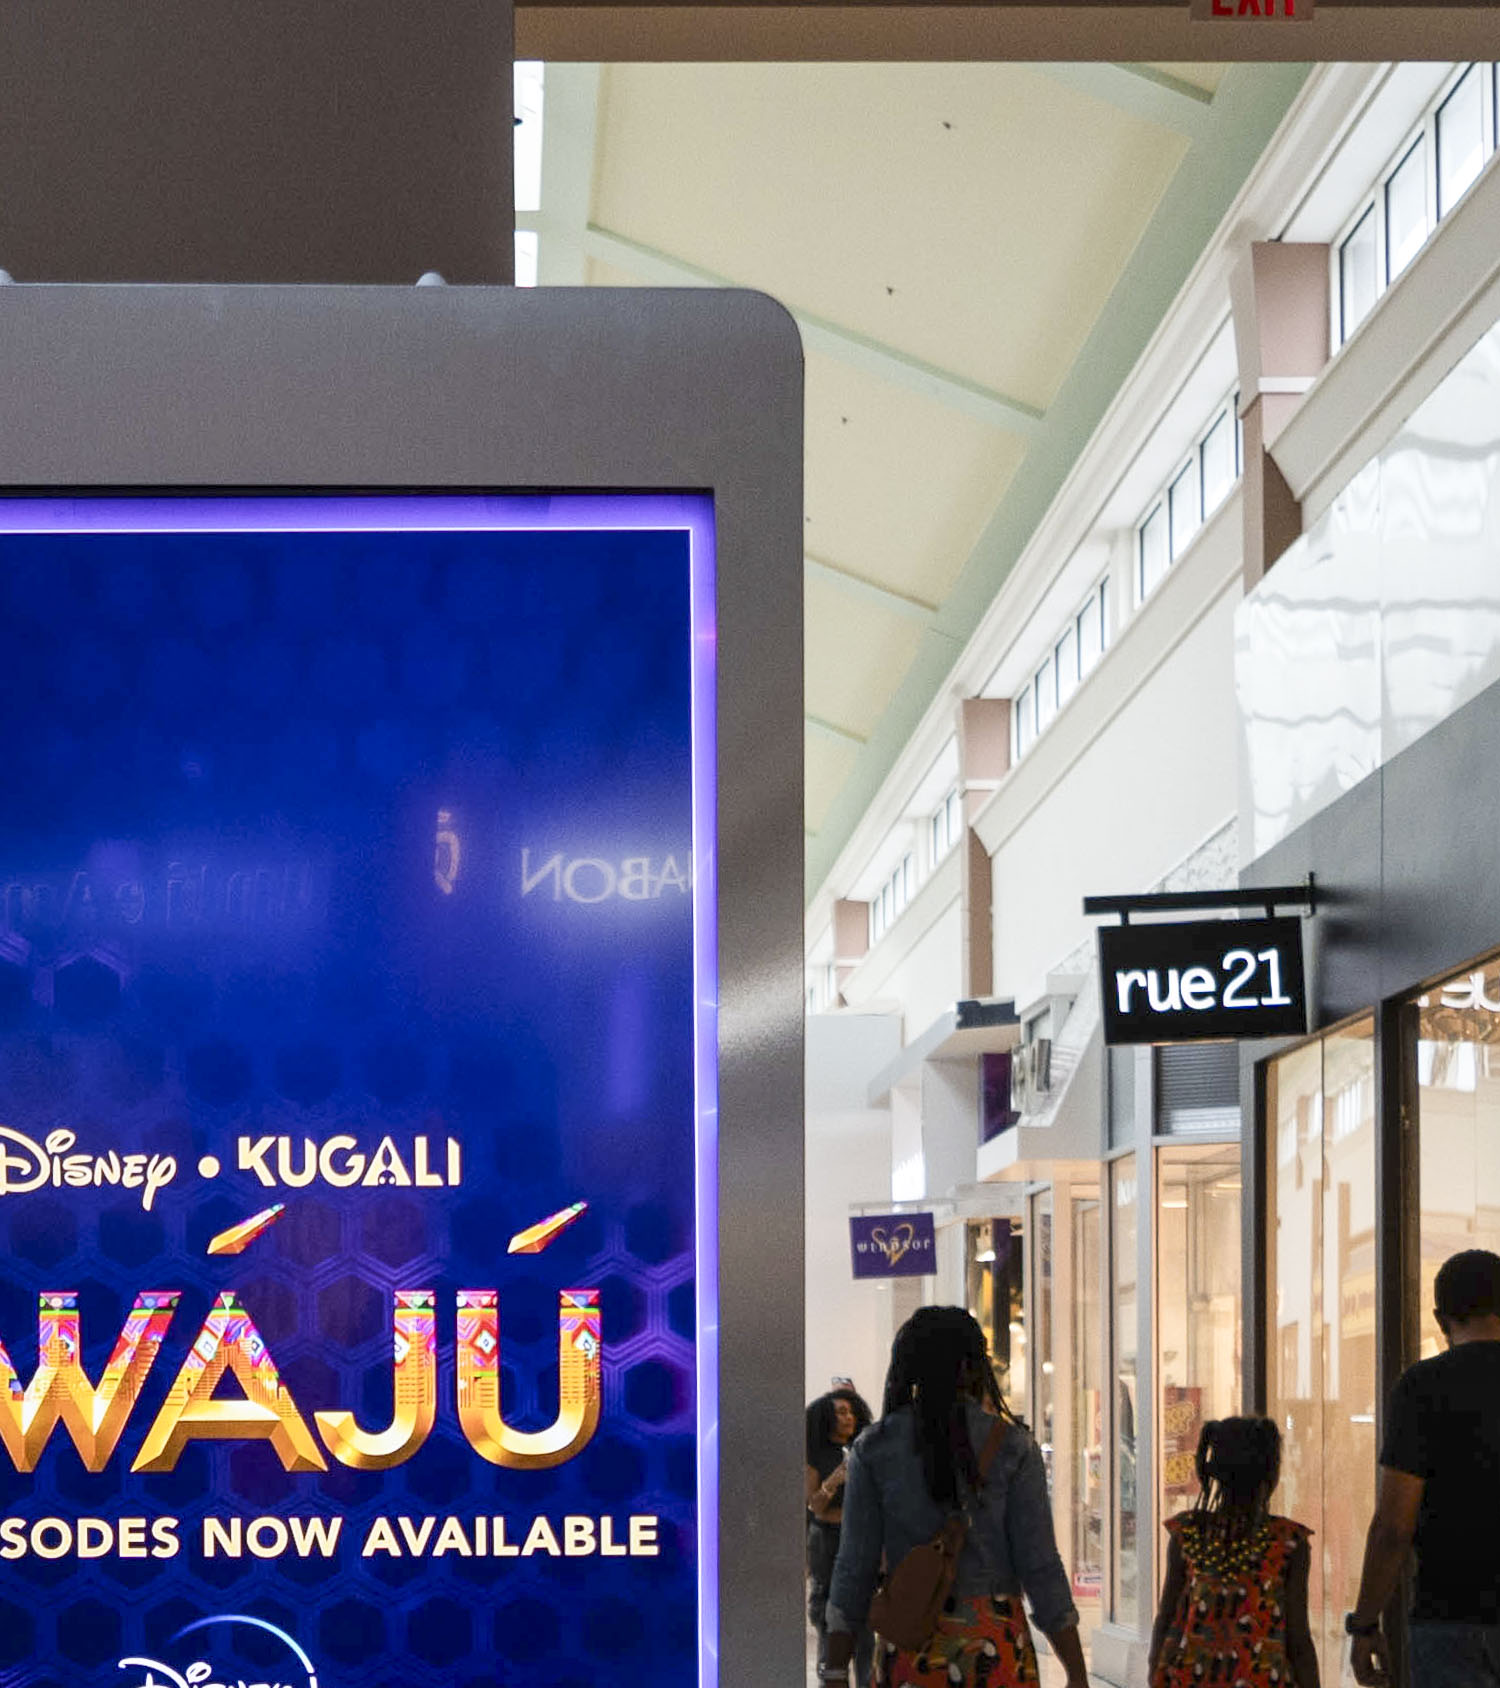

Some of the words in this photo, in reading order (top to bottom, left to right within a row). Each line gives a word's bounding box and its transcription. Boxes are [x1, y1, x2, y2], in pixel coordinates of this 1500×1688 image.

[1115, 947, 1292, 1014] rue21
[237, 1134, 461, 1187] KUGALI
[203, 1518, 343, 1558] NOW
[363, 1516, 659, 1557] AVAILABLE
